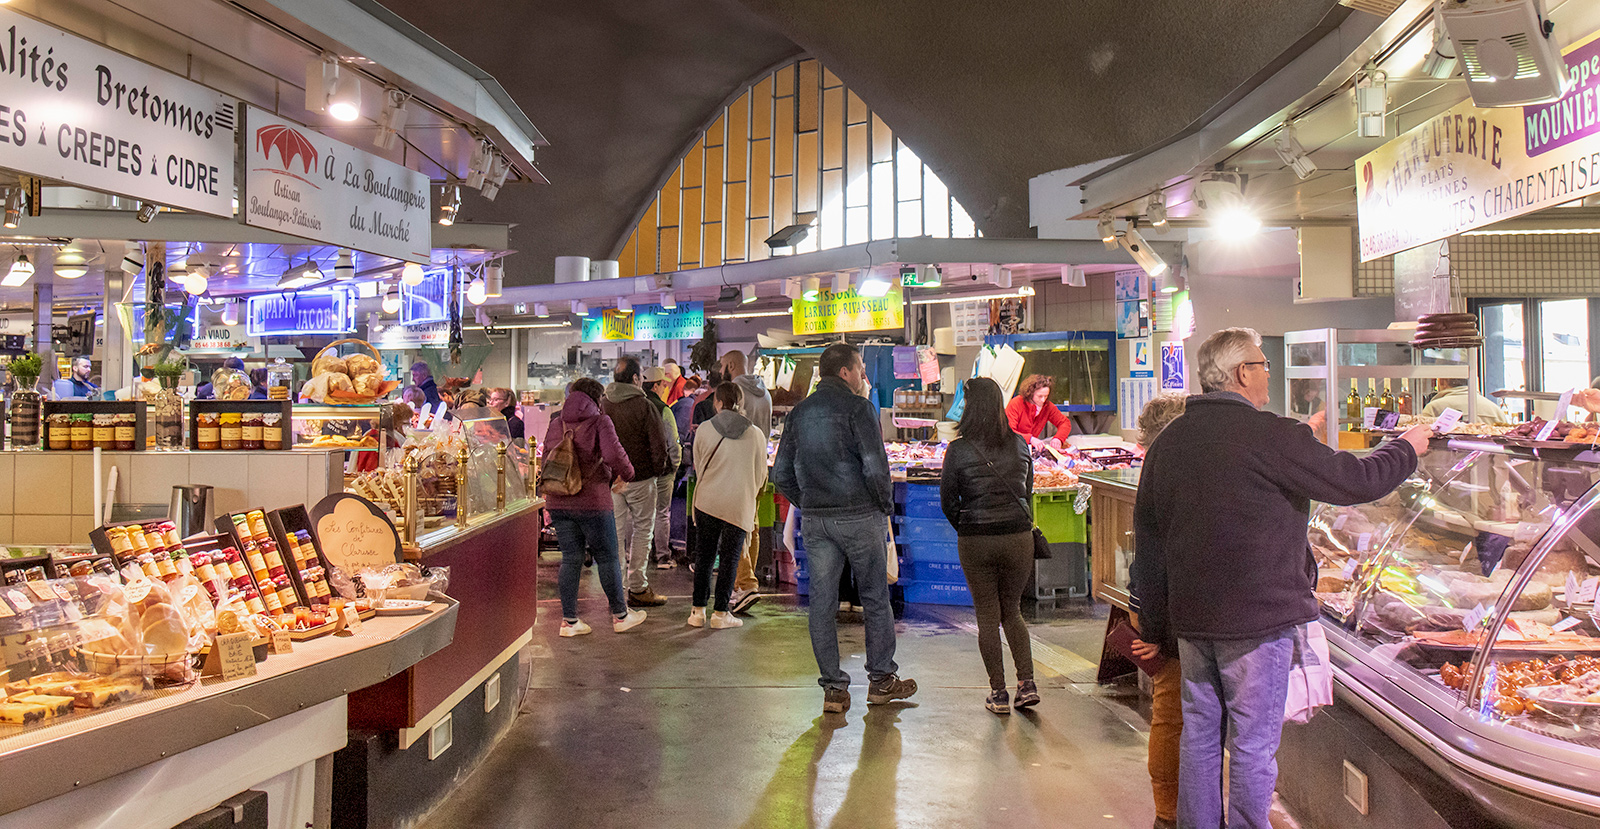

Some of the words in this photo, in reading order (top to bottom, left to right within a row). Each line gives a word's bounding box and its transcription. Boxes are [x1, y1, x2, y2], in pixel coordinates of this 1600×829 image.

[95, 64, 214, 139] Bretonnes
[57, 123, 142, 176] CREPES
[166, 154, 218, 196] CIDRE
[1385, 114, 1502, 208] CHARCUTERIE
[323, 148, 336, 182] À
[342, 162, 361, 188] La
[363, 168, 426, 212] Boulangerie
[1421, 163, 1454, 187] PLATS
[274, 178, 301, 203] Artisan
[250, 196, 322, 231] Boulanger-Pâtissier
[350, 205, 366, 231] du
[368, 210, 410, 243] Marché
[265, 298, 297, 319] PAPIN
[296, 307, 332, 330] JACOB
[208, 329, 231, 340] VIAUD
[636, 318, 670, 330] COQUILLAGES
[672, 316, 702, 328] CRUSTACES
[325, 520, 342, 534] Les
[346, 520, 384, 537] Confitures
[341, 543, 379, 557] Clarisse
